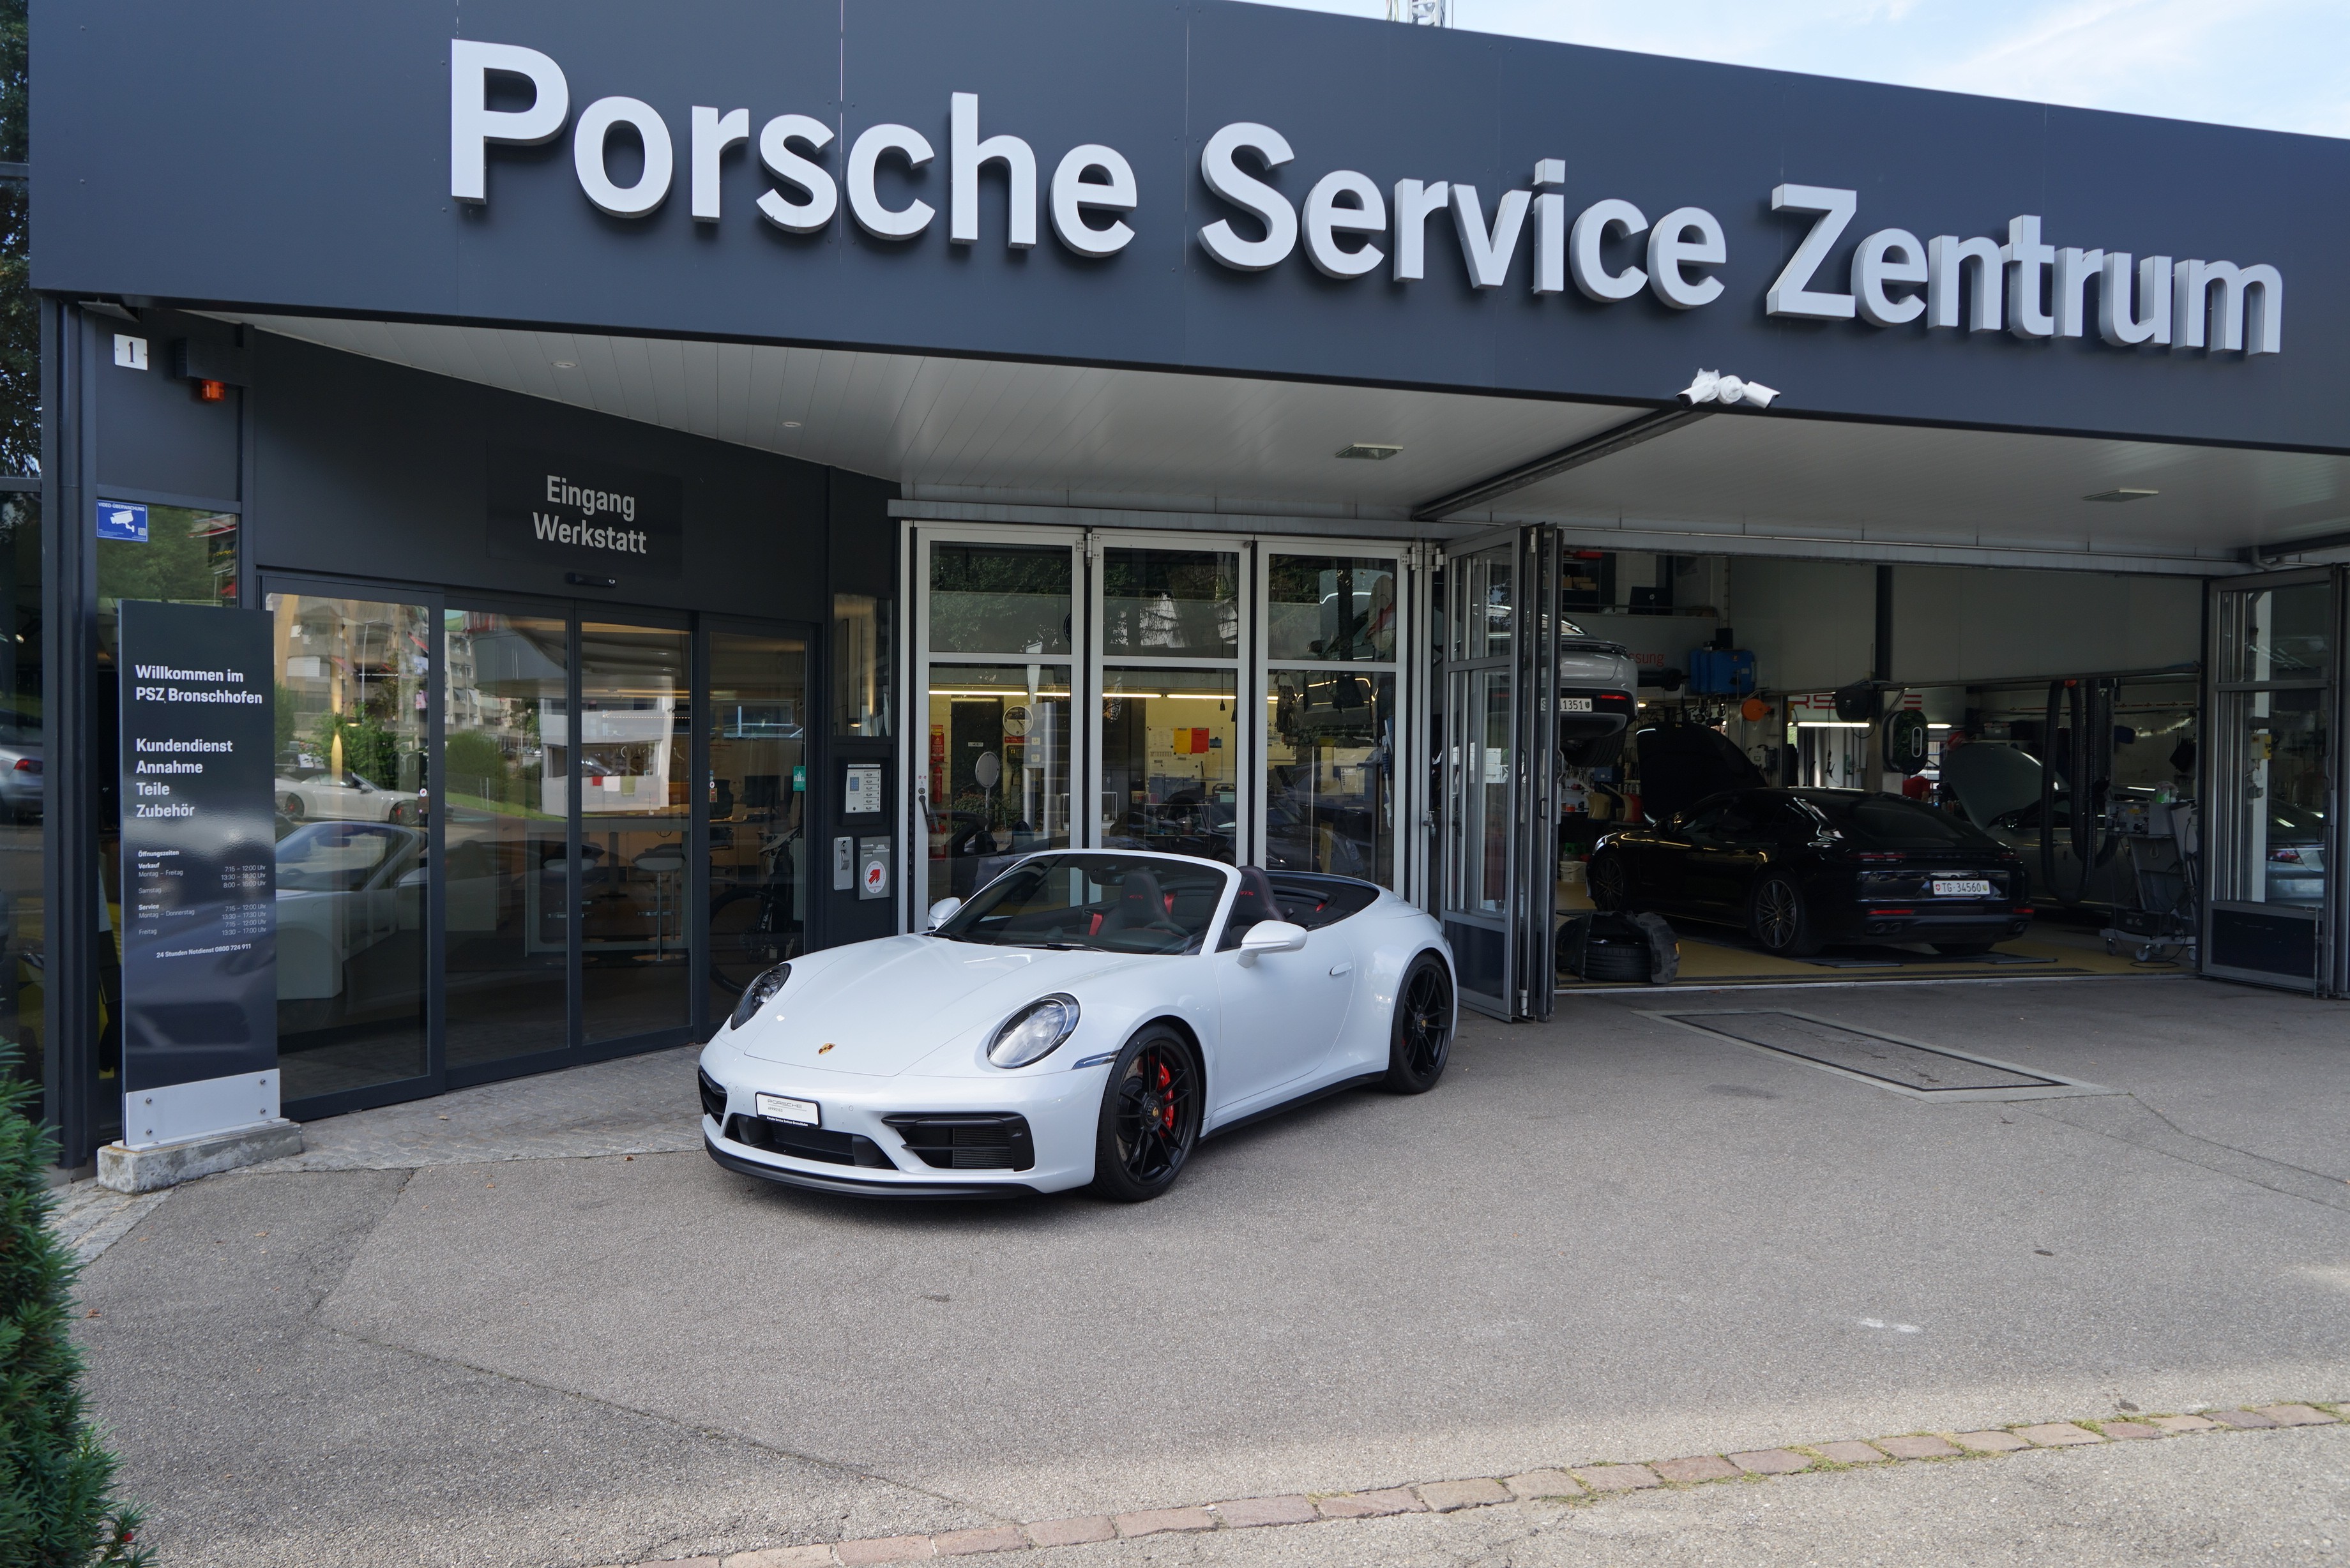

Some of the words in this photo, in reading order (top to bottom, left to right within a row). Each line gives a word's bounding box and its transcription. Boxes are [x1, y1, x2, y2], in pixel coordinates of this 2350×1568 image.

[451, 38, 1137, 258] Porsche
[1196, 122, 1727, 311] Service
[1766, 184, 2282, 356] Zentrum
[128, 341, 135, 363] 1
[547, 474, 635, 522] Eingang
[98, 502, 145, 512] VIDEO-ÜBERWACHUNG
[533, 511, 647, 555] Werkstatt
[135, 665, 224, 682] Willkommen
[227, 668, 244, 682] im
[136, 687, 165, 701] PSZ
[168, 688, 262, 704] Bronschhofen
[136, 738, 233, 753] Kundendienst
[136, 760, 203, 774] Annahme
[136, 782, 170, 795] Teile
[136, 803, 195, 818] Zubehör
[767, 1099, 802, 1108] PORSCHE
